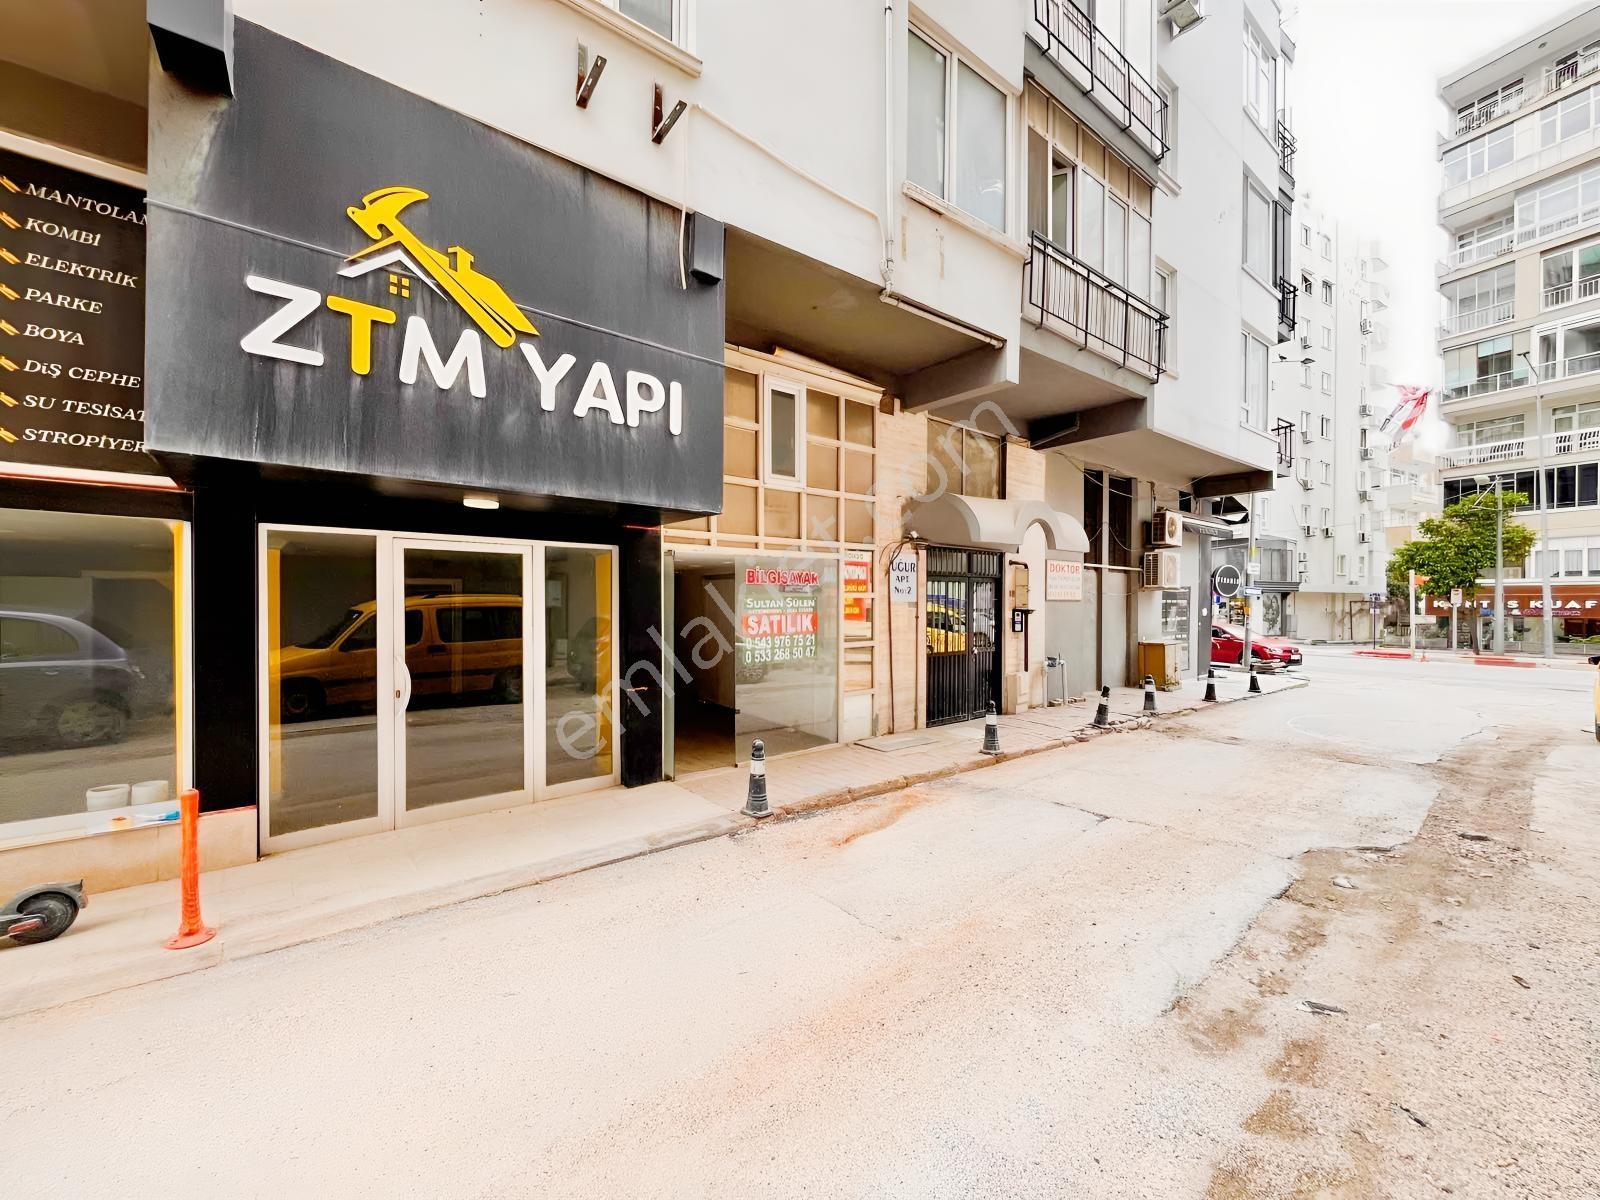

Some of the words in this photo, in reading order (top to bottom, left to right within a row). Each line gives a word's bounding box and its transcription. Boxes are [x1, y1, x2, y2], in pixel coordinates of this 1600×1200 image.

[25, 217, 101, 247] KOMBİ
[24, 252, 138, 288] ELEKTRİK
[24, 287, 103, 314] PARKE
[23, 323, 85, 345] BOYA
[240, 274, 487, 399] ZTM
[519, 342, 682, 436] YAPI
[68, 366, 141, 388] CEPHE
[23, 394, 56, 409] SU
[746, 598, 784, 609] SULTAN
[747, 614, 814, 635] SATILIK
[774, 635, 791, 648] 976
[745, 650, 752, 663] 0
[774, 648, 790, 661] 268
